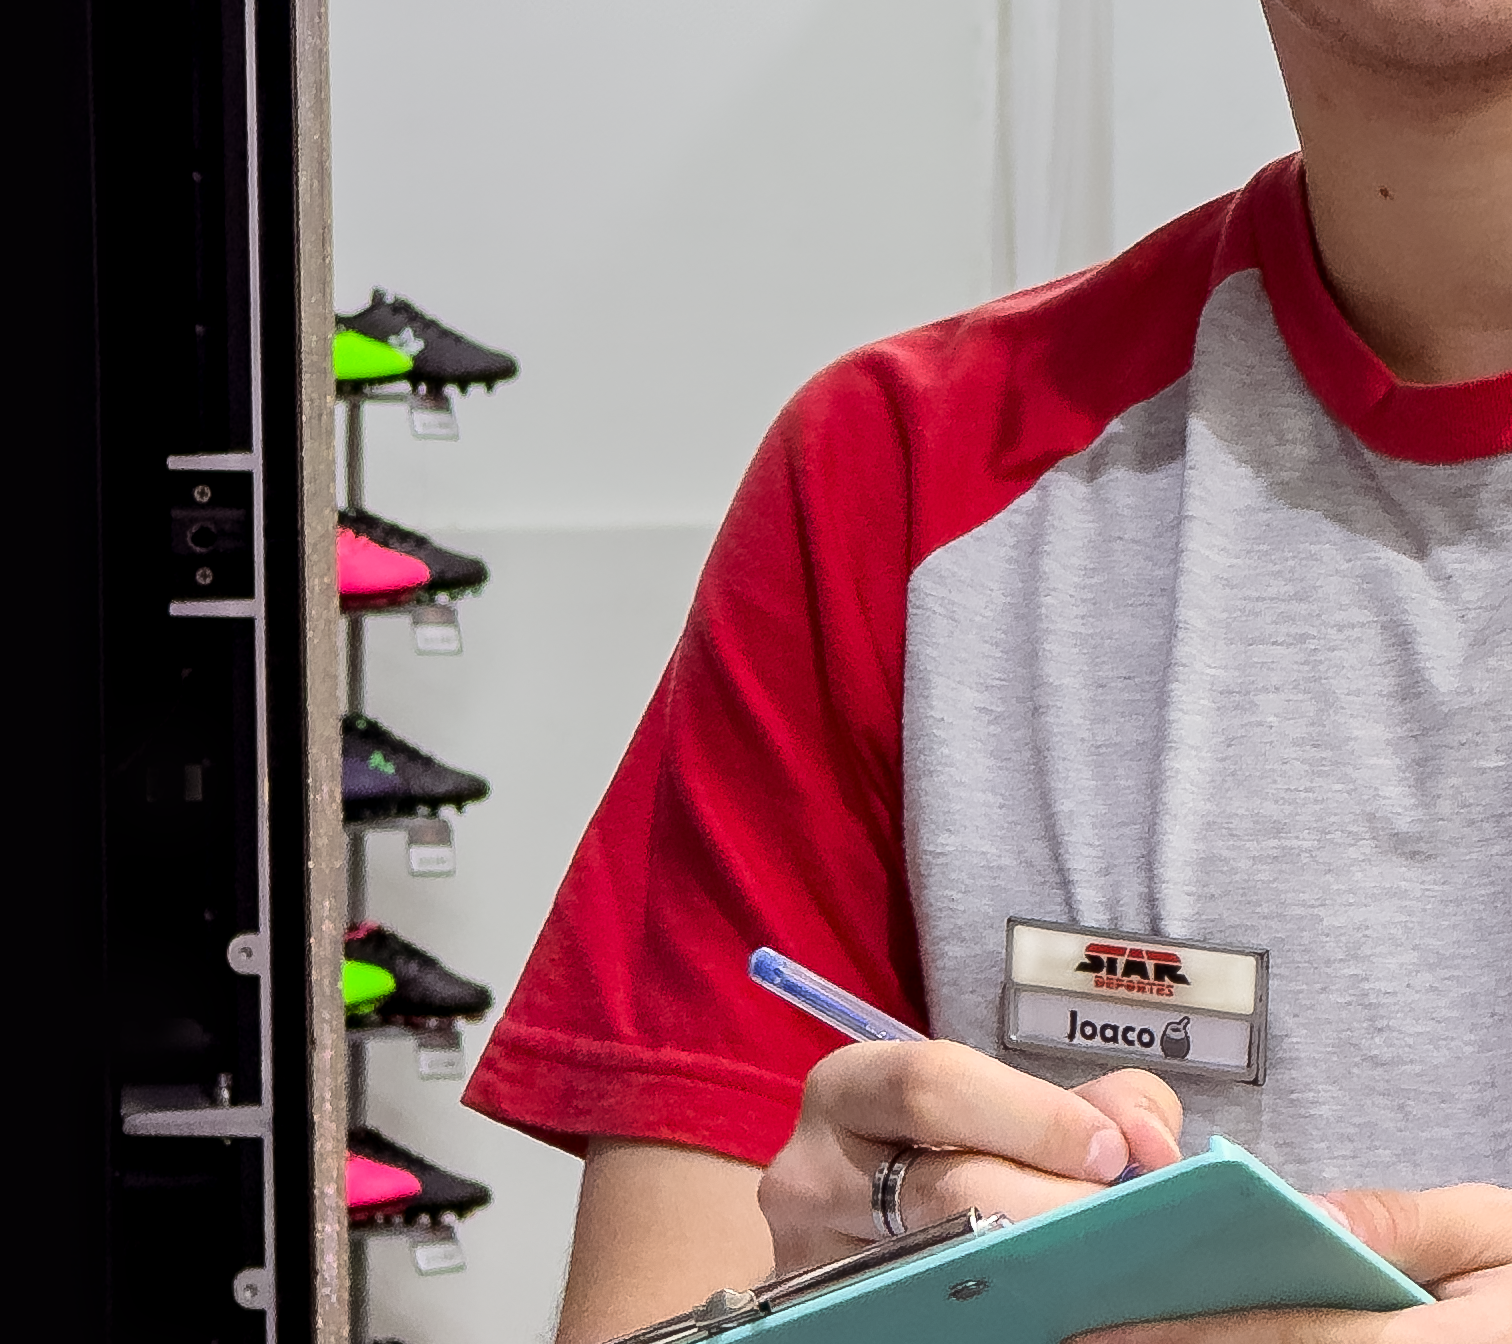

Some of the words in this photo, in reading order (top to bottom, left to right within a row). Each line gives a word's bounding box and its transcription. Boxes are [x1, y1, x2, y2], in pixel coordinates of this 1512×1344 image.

[1074, 942, 1192, 986] STAR
[1094, 975, 1175, 997] DEPORTES
[1067, 1009, 1156, 1049] Joaco
